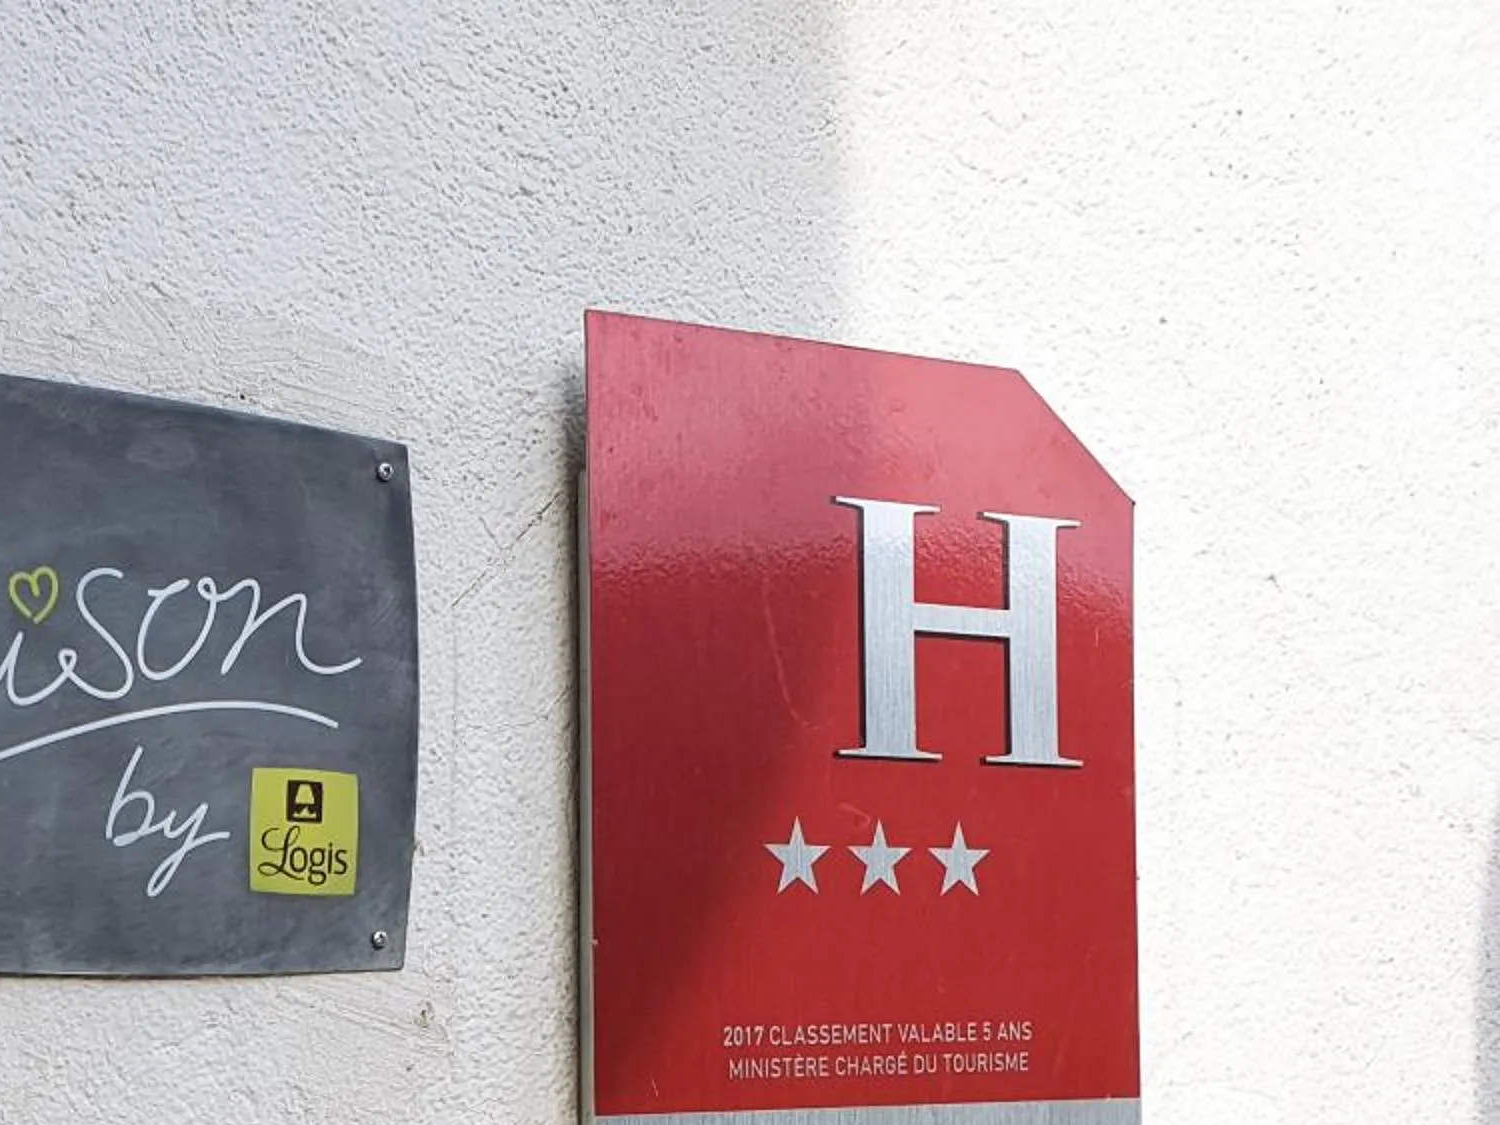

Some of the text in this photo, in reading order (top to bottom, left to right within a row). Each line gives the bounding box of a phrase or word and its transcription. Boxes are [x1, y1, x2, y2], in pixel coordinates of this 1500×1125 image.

[831, 496, 1084, 768] H
[105, 746, 349, 897] by Logis
[723, 1021, 1033, 1048] 2017 CLASSEMENT VALABLE 5 ANS
[728, 1050, 1030, 1079] MINISTÈRE CHARGÉ DU TOURISME
